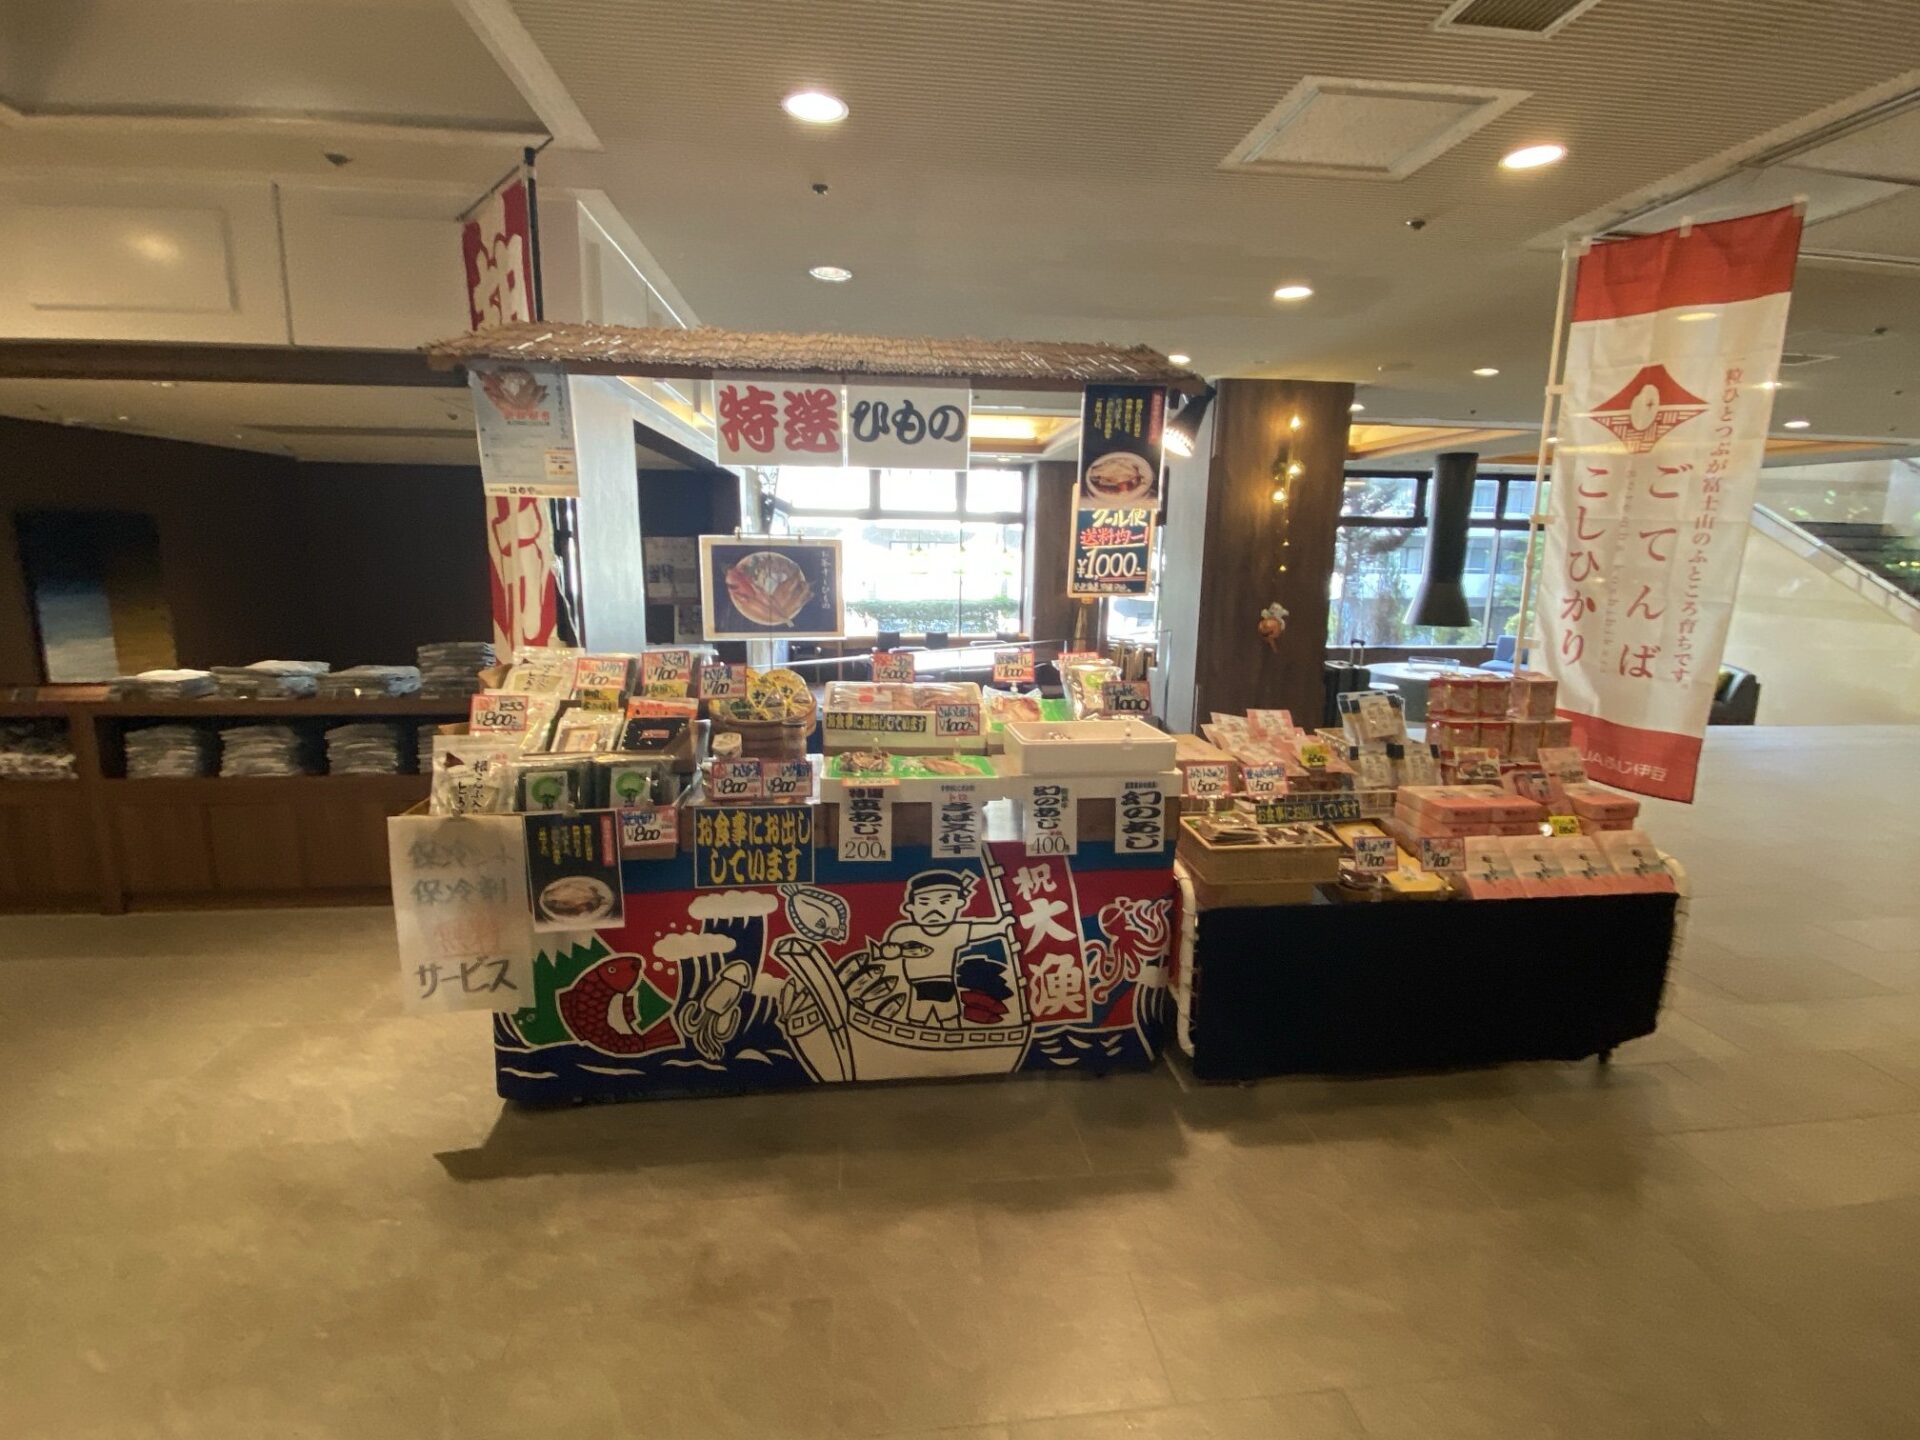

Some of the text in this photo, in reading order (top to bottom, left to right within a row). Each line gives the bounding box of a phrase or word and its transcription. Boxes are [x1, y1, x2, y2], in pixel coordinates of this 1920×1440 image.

[719, 385, 840, 453] 特選
[851, 399, 966, 445] ひもの
[1561, 465, 1609, 667] こしひかり
[1619, 463, 1694, 679] ごてんば
[698, 808, 811, 848] お食事にお出し
[710, 845, 803, 885] しています
[1012, 863, 1086, 1017] 祝大漁
[415, 955, 518, 999] サービス
